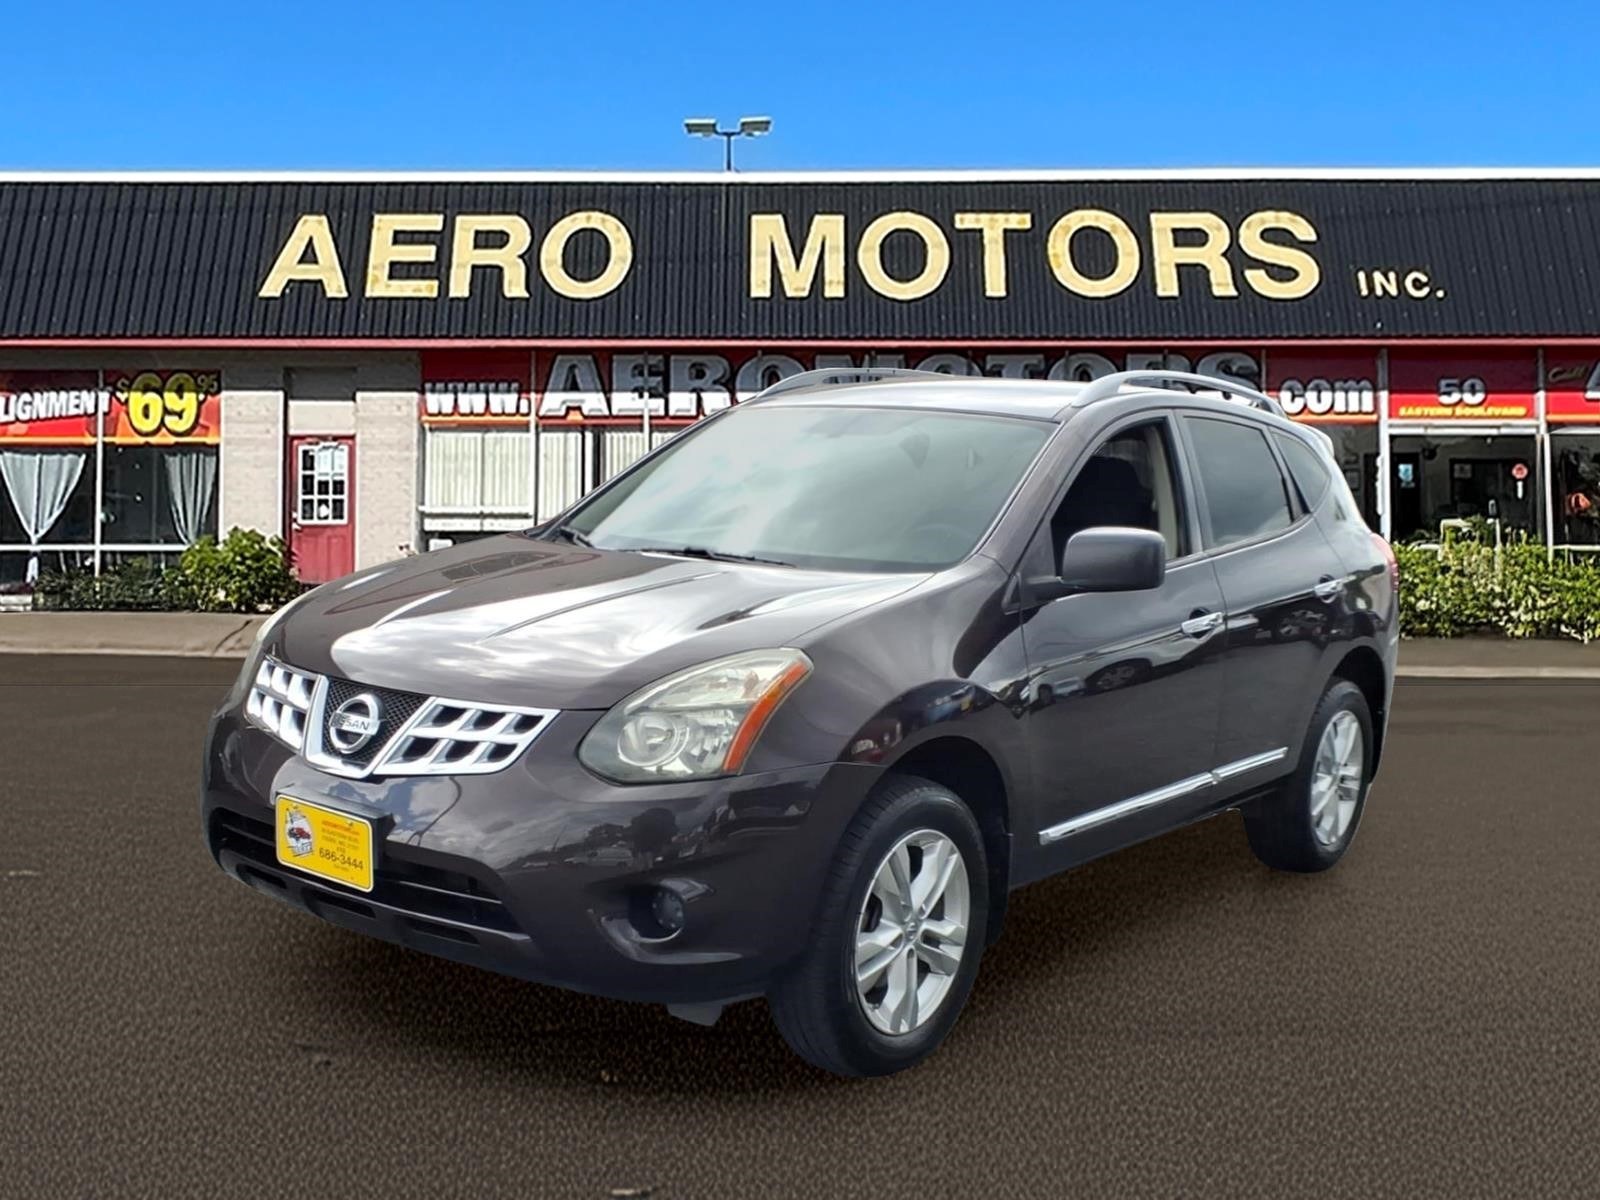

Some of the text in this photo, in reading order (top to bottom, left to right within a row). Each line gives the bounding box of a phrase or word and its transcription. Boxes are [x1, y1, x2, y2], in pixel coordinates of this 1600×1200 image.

[258, 209, 1445, 301] AERO MOTORS INC.
[538, 352, 1261, 416] AEROTS
[1438, 378, 1486, 405] 50
[332, 711, 371, 731] SSAN
[318, 847, 364, 870] 686-3444
